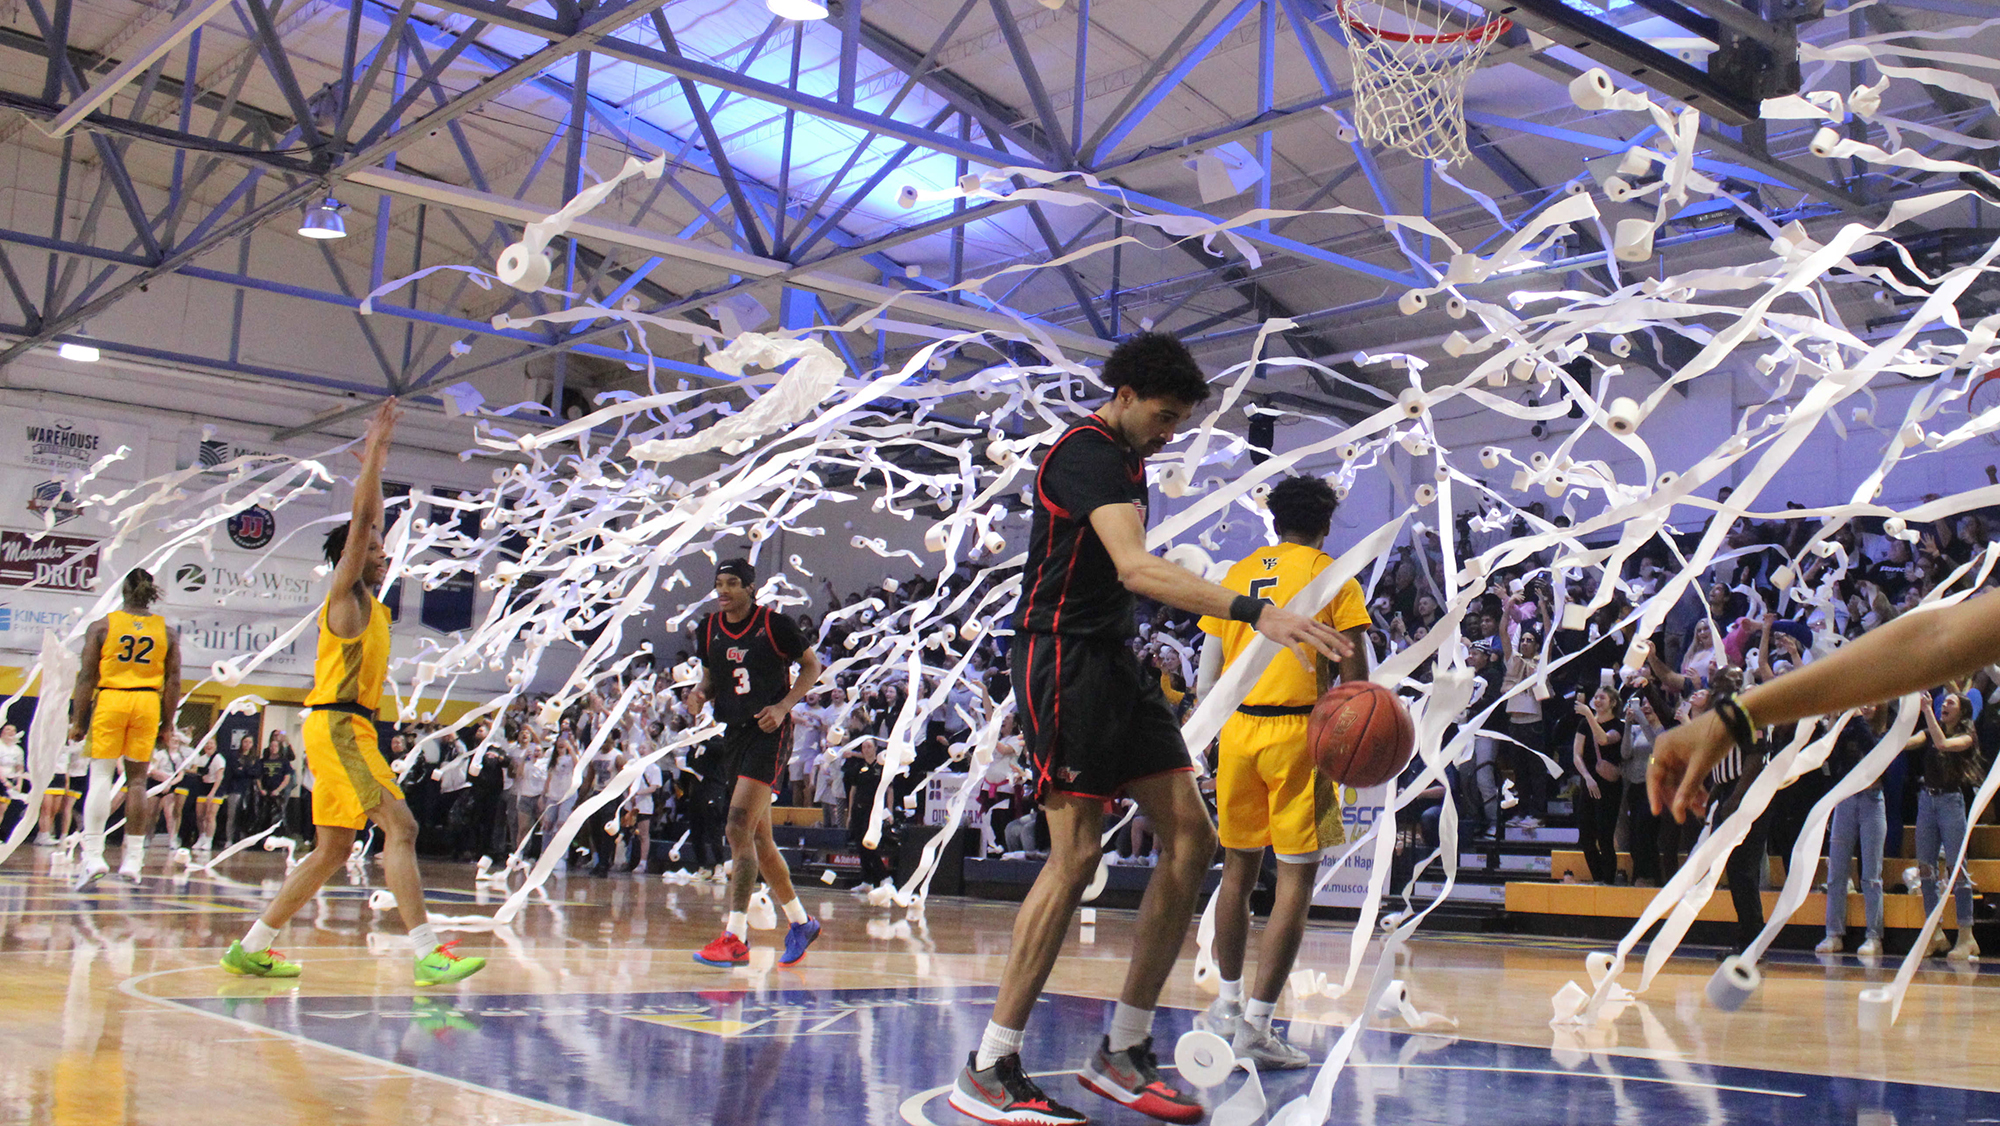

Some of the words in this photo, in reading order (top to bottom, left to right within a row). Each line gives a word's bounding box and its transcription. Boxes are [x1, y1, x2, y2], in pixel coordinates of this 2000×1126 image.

[26, 425, 99, 450] WAREHOUSE
[1, 540, 64, 562] Mahaska
[36, 562, 95, 590] DRUG
[262, 572, 314, 594] WEST
[117, 634, 155, 664] 32
[726, 646, 750, 664] GV
[732, 667, 752, 696] 3
